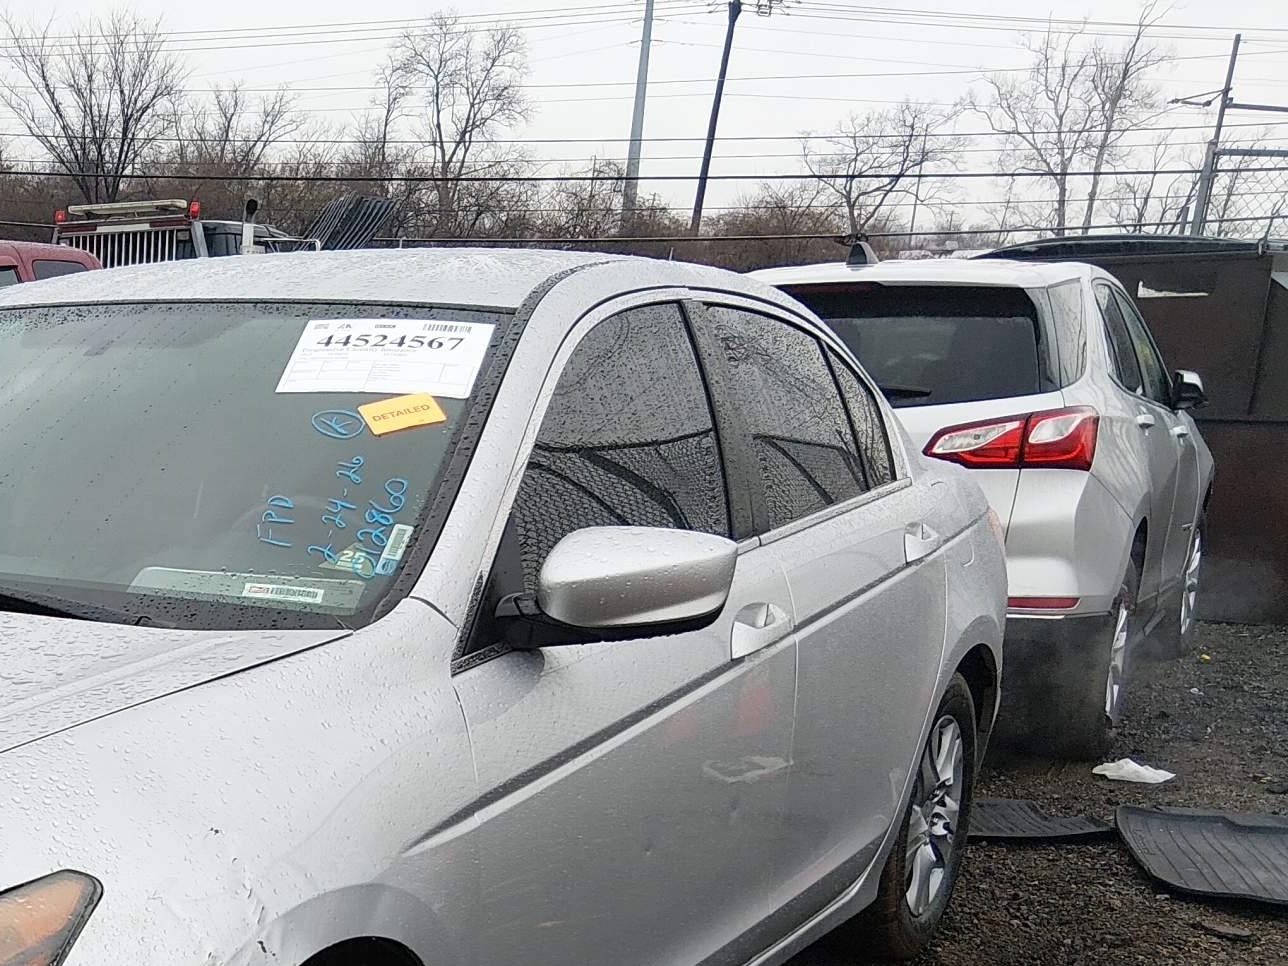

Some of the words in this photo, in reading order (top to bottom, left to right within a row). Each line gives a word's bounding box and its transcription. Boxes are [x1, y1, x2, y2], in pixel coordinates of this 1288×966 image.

[316, 334, 464, 351] 44524567
[372, 404, 431, 422] DETAILED
[256, 495, 296, 547] FPD
